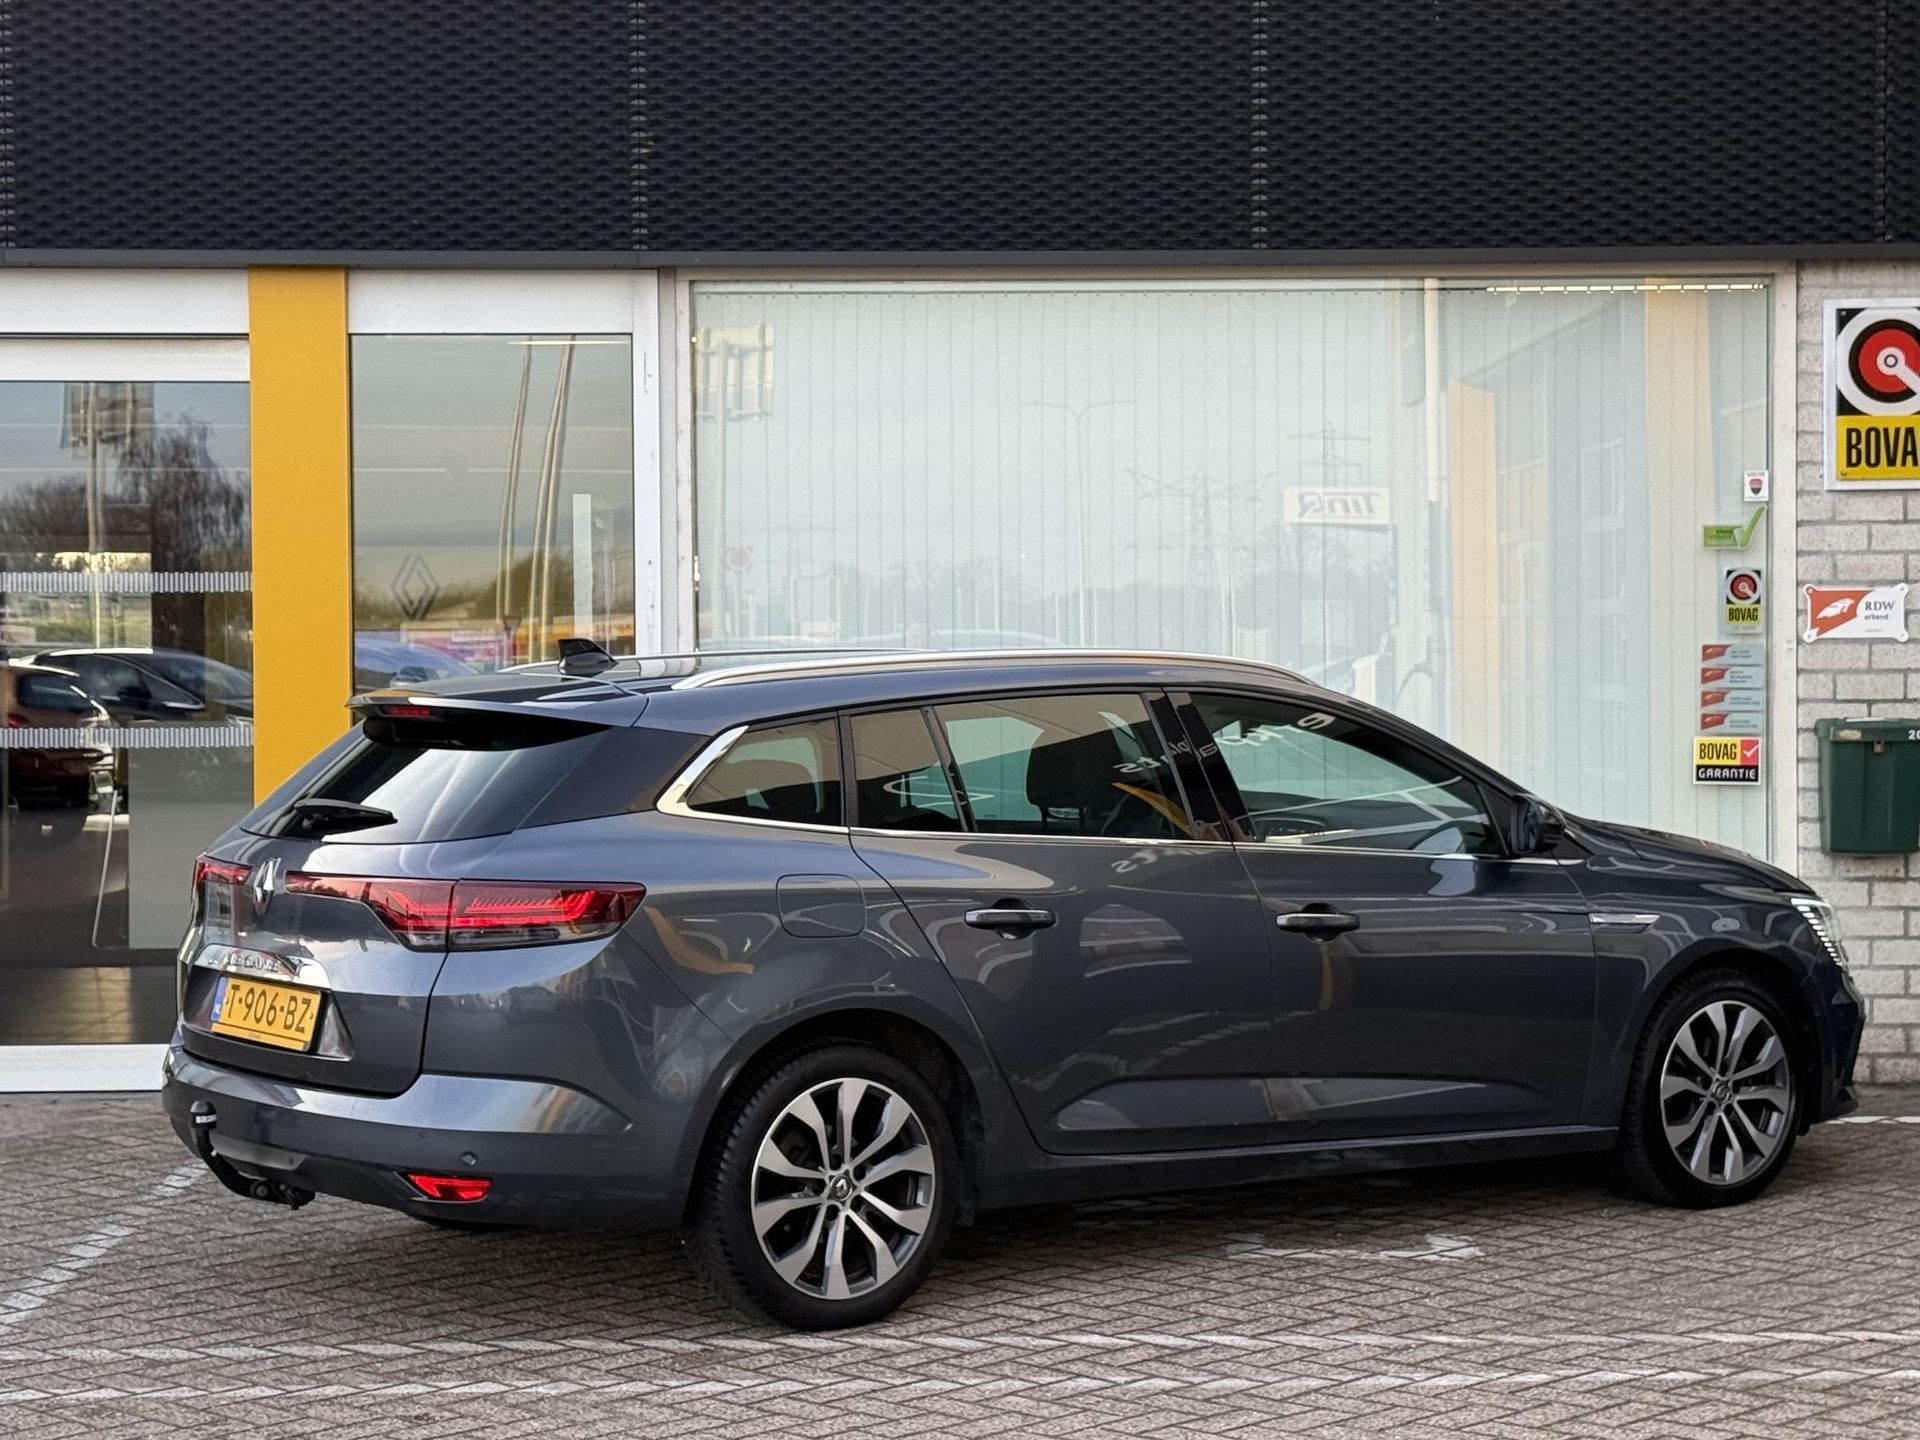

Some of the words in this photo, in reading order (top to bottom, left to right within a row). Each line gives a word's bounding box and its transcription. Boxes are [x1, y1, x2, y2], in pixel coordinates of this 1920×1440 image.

[1846, 427, 1918, 468] BOVA
[1865, 600, 1895, 611] RDW
[1728, 607, 1758, 621] BOVAG
[1699, 743, 1737, 760] BOVAG
[1698, 768, 1757, 779] GARANTIE
[229, 984, 311, 1034] T-906-BZ
